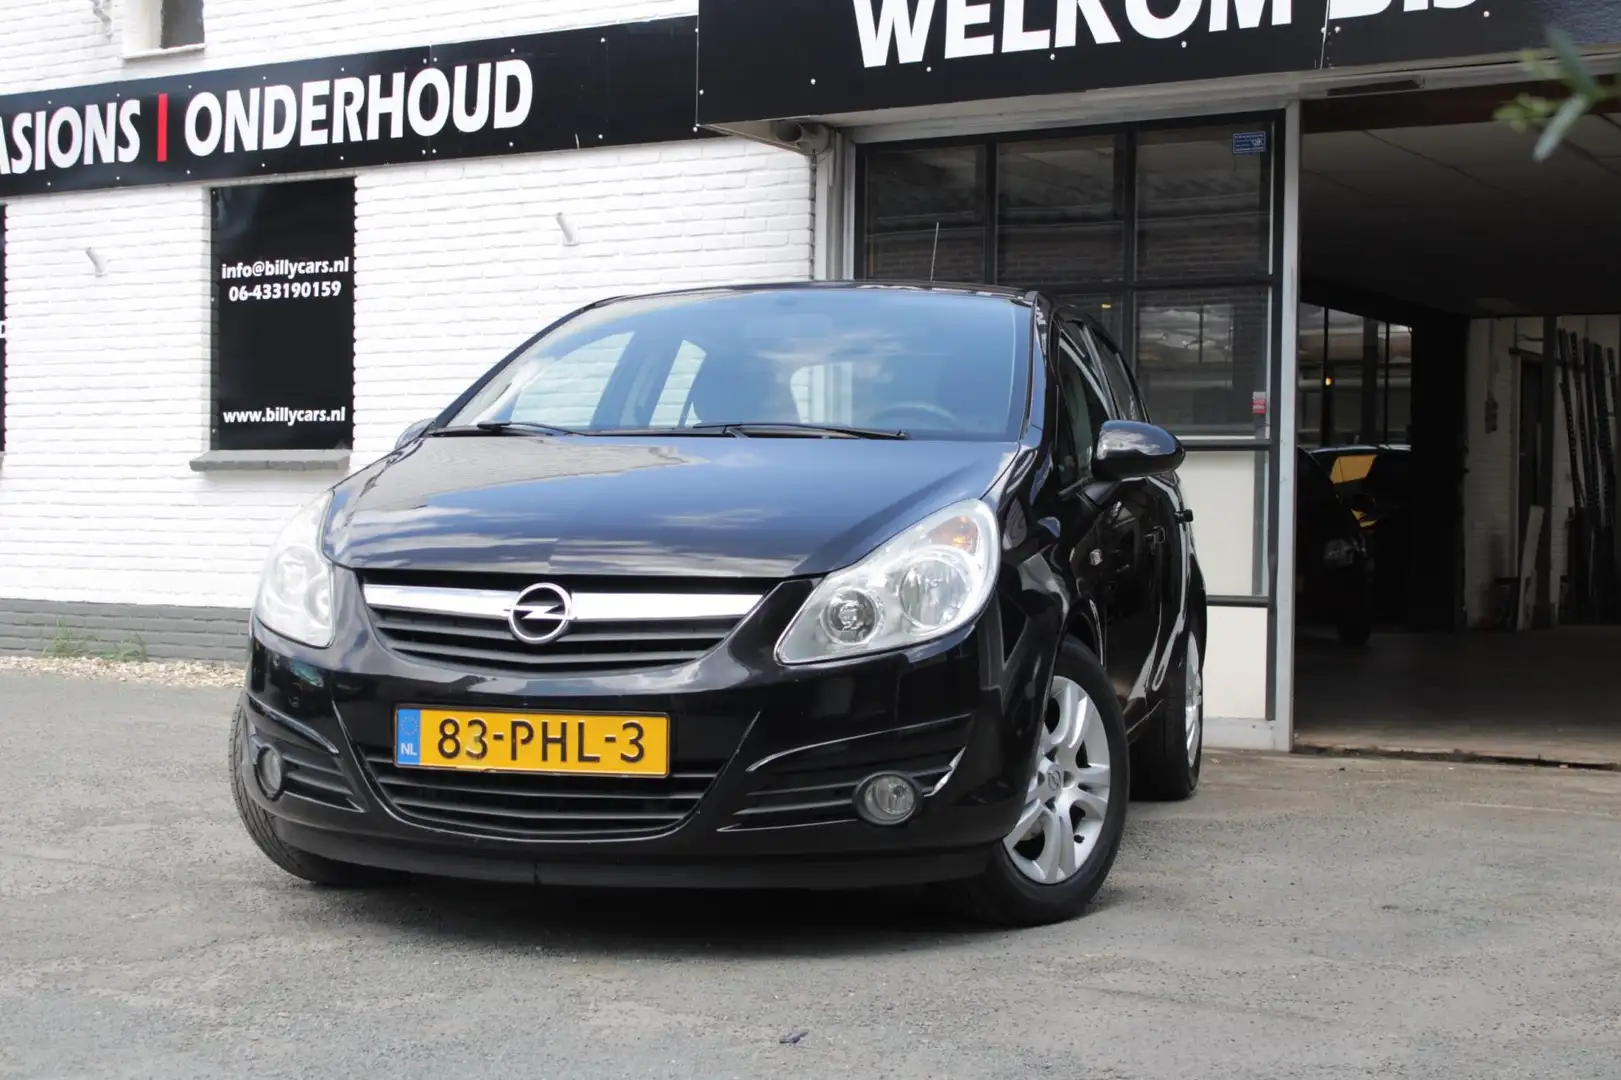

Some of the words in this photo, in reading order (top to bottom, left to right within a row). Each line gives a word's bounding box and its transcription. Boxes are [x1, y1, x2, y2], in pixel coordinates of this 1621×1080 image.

[0, 99, 141, 175] SIONS
[184, 59, 534, 157] ONDERHOUD
[222, 256, 350, 280] info@billycars.nl
[229, 281, 342, 302] 06-433190159
[223, 406, 346, 427] www.billycars.nl
[400, 743, 418, 756] NL
[437, 717, 646, 764] 83-PHL-3
